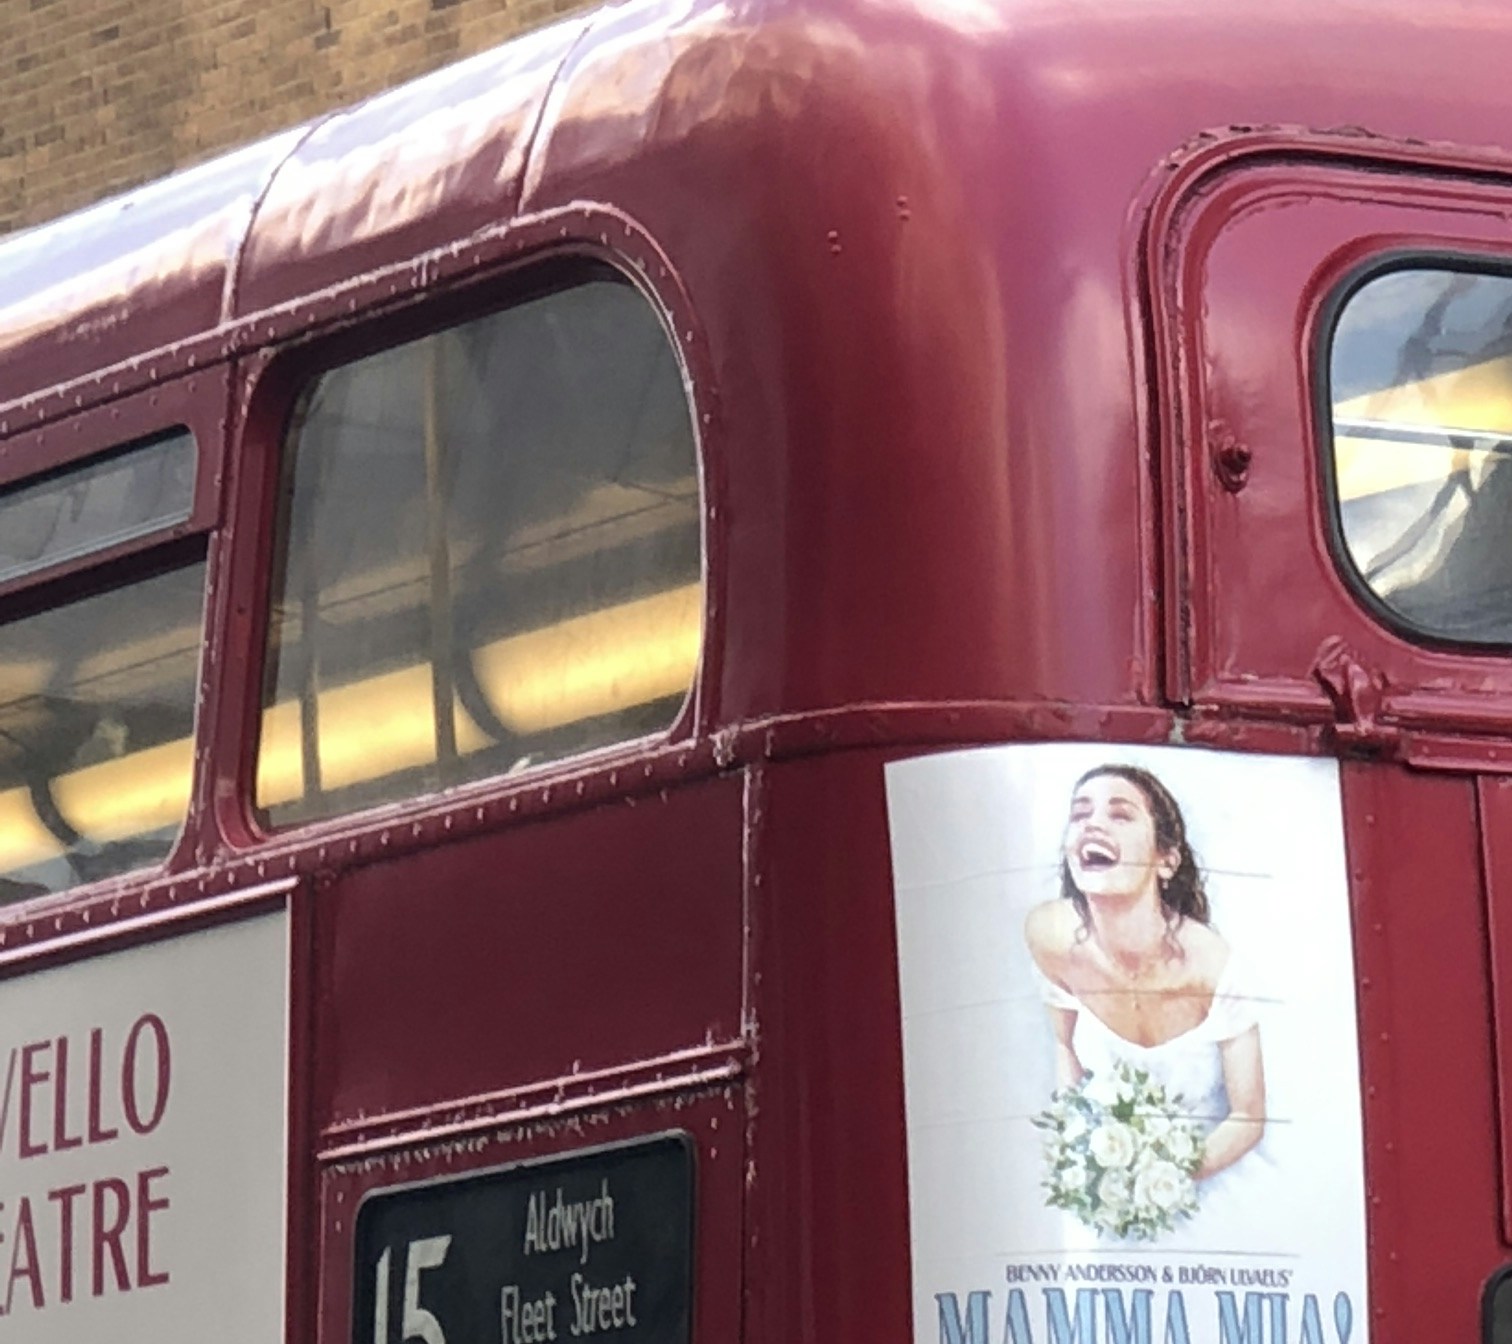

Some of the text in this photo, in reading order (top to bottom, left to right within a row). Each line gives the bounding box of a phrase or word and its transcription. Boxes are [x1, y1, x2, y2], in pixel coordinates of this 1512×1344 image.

[0, 1166, 169, 1316] ATRE
[524, 1183, 614, 1264] Aldwych
[570, 1275, 636, 1334] Street
[1007, 1264, 1061, 1283] BENNY
[1064, 1265, 1157, 1283] ANDERSSON
[1162, 1266, 1172, 1283] &
